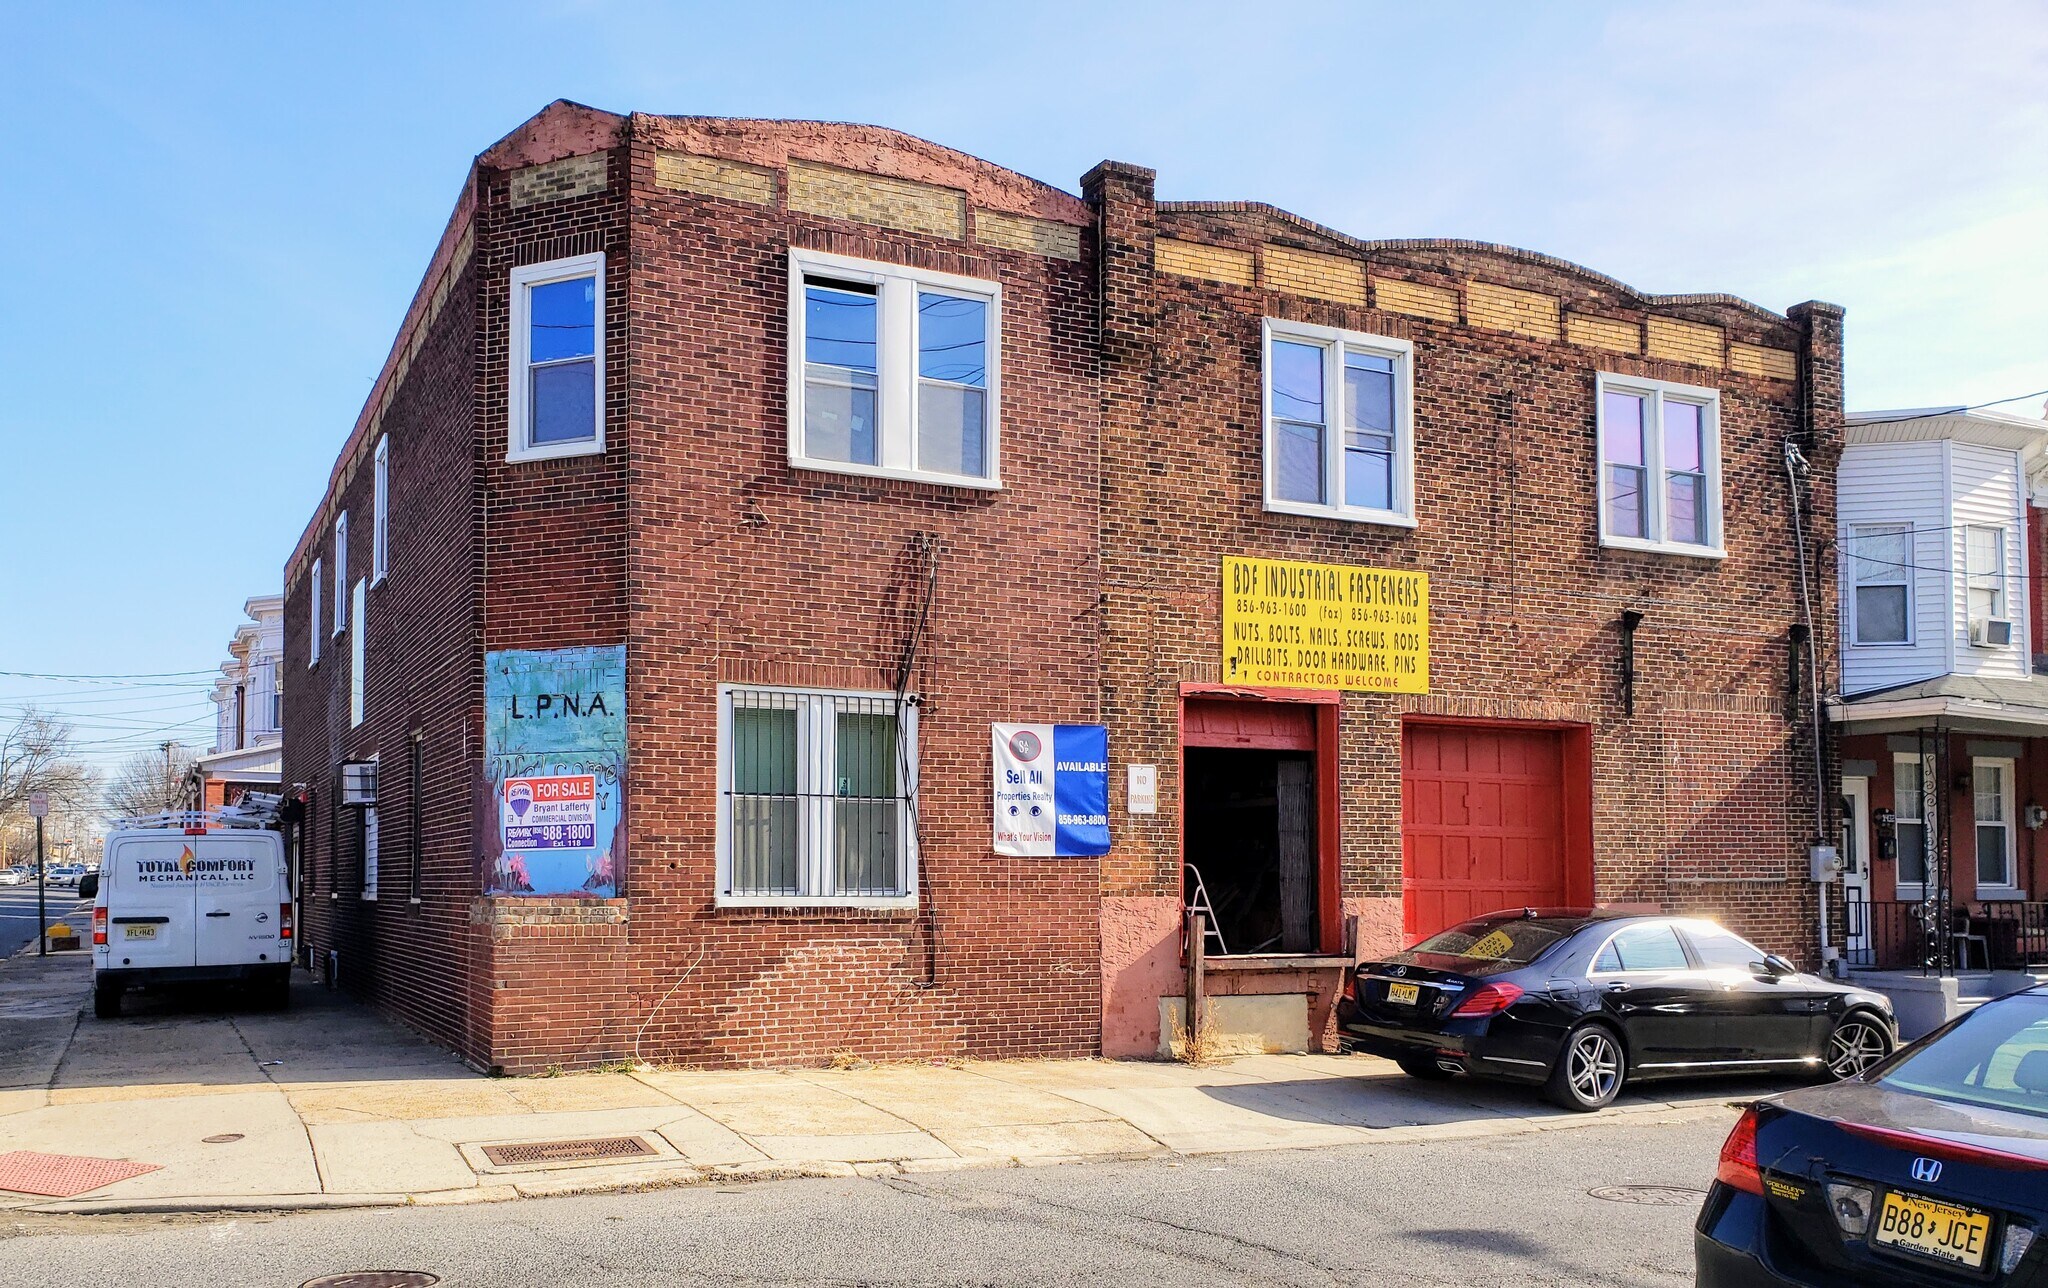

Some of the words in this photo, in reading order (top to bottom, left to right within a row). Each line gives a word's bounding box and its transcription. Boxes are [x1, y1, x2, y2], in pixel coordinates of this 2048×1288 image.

[1233, 562, 1258, 596] BDF
[1265, 565, 1343, 602] INDUSTRIAL
[1349, 572, 1419, 607] FASTENERS
[1236, 599, 1307, 617] 856-963-1600
[1319, 605, 1343, 622] (fax)
[1351, 608, 1417, 625] 856-963-1604
[1393, 632, 1419, 651] RODS
[1297, 649, 1327, 669] DOOR
[1394, 655, 1416, 674] PINS
[1257, 670, 1339, 685] CONTRACTORS
[1345, 675, 1398, 688] WELCOME
[511, 692, 614, 718] L.P.N.A.
[1056, 762, 1107, 772] AVAILABLE
[1006, 769, 1026, 784] Sell
[1029, 770, 1042, 784] All
[1136, 775, 1147, 785] NO
[537, 783, 559, 798] FOR
[561, 781, 590, 797] SALE
[996, 791, 1031, 803] Properties
[1032, 791, 1053, 803] Realty
[1131, 794, 1154, 804] PARKING
[534, 803, 559, 814] Bryant
[560, 802, 590, 812] Lafferty
[532, 814, 567, 823] COMMERCIAL
[568, 813, 592, 822] DIVISION
[1058, 814, 1107, 826] 856-963-8800
[543, 824, 591, 840] 988-1800
[997, 831, 1017, 842] What's
[1019, 831, 1032, 842] Your
[1033, 831, 1052, 842] Vision
[568, 839, 581, 847] 118
[136, 860, 182, 872] TOTAL
[186, 859, 256, 872] COMFORT
[139, 874, 229, 882] MECHANICAL,
[1908, 1198, 1933, 1210] New
[1931, 1204, 1965, 1219] Jersey
[1883, 1204, 1925, 1239] B88
[1937, 1219, 1983, 1254] JCE
[1899, 1239, 1930, 1253] Garden
[1931, 1247, 1955, 1260] State
